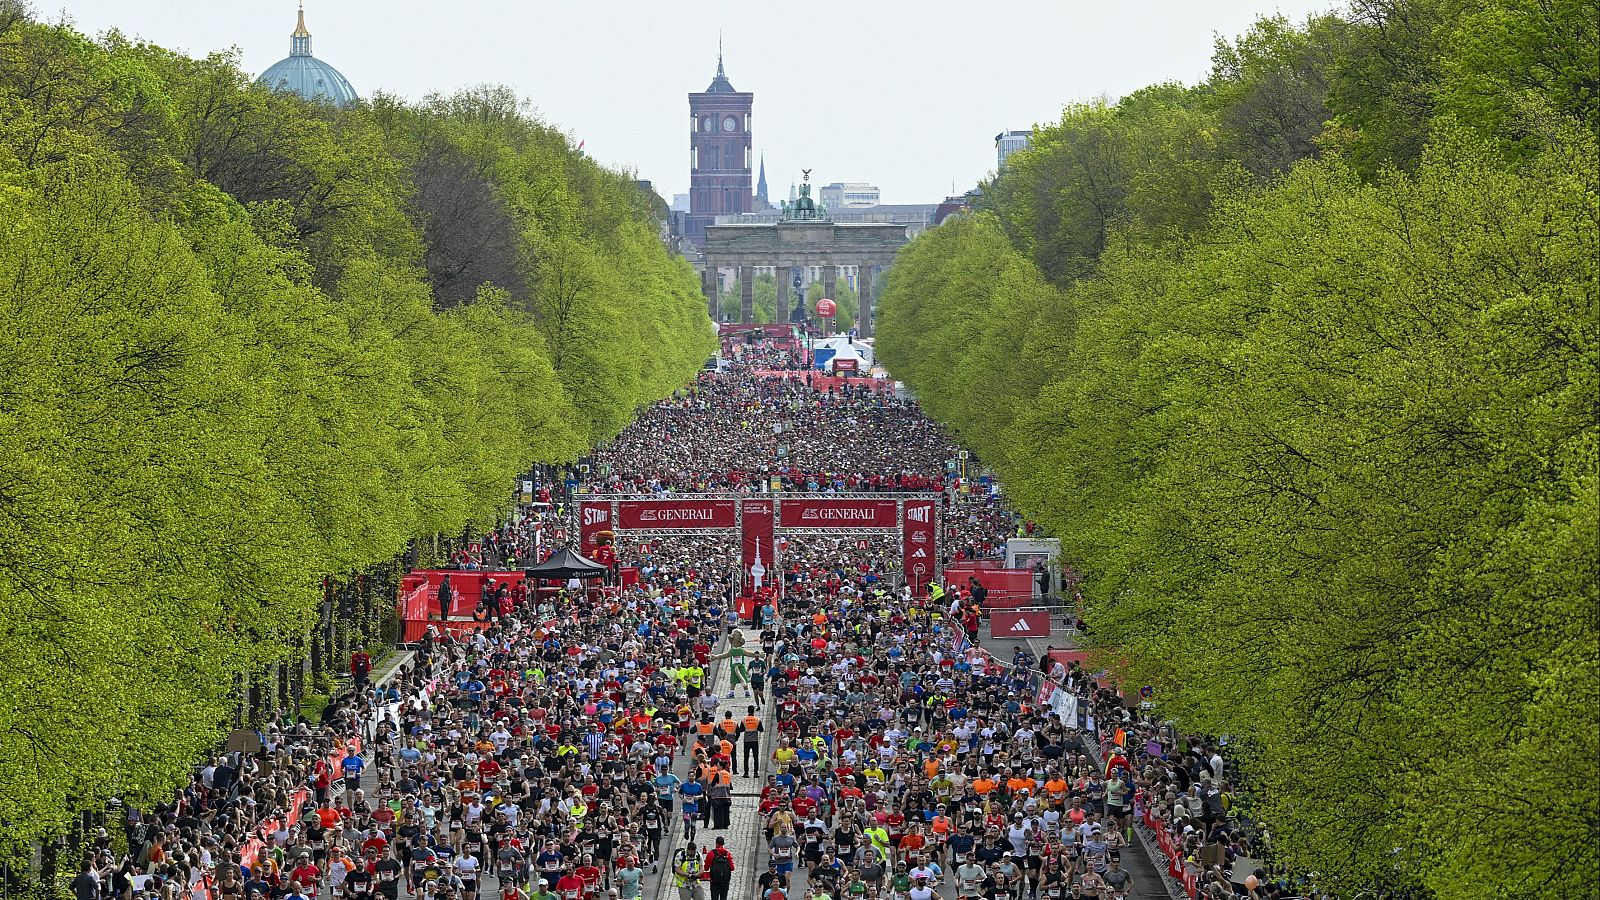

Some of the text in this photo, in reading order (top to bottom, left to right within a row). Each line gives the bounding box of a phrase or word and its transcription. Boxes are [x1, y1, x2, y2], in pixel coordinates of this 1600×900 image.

[657, 509, 714, 520] GENERALI
[819, 508, 876, 520] GENERALI
[907, 505, 931, 523] START
[556, 531, 564, 539] A
[470, 544, 478, 553] A
[641, 544, 649, 554] A
[859, 540, 866, 550] A
